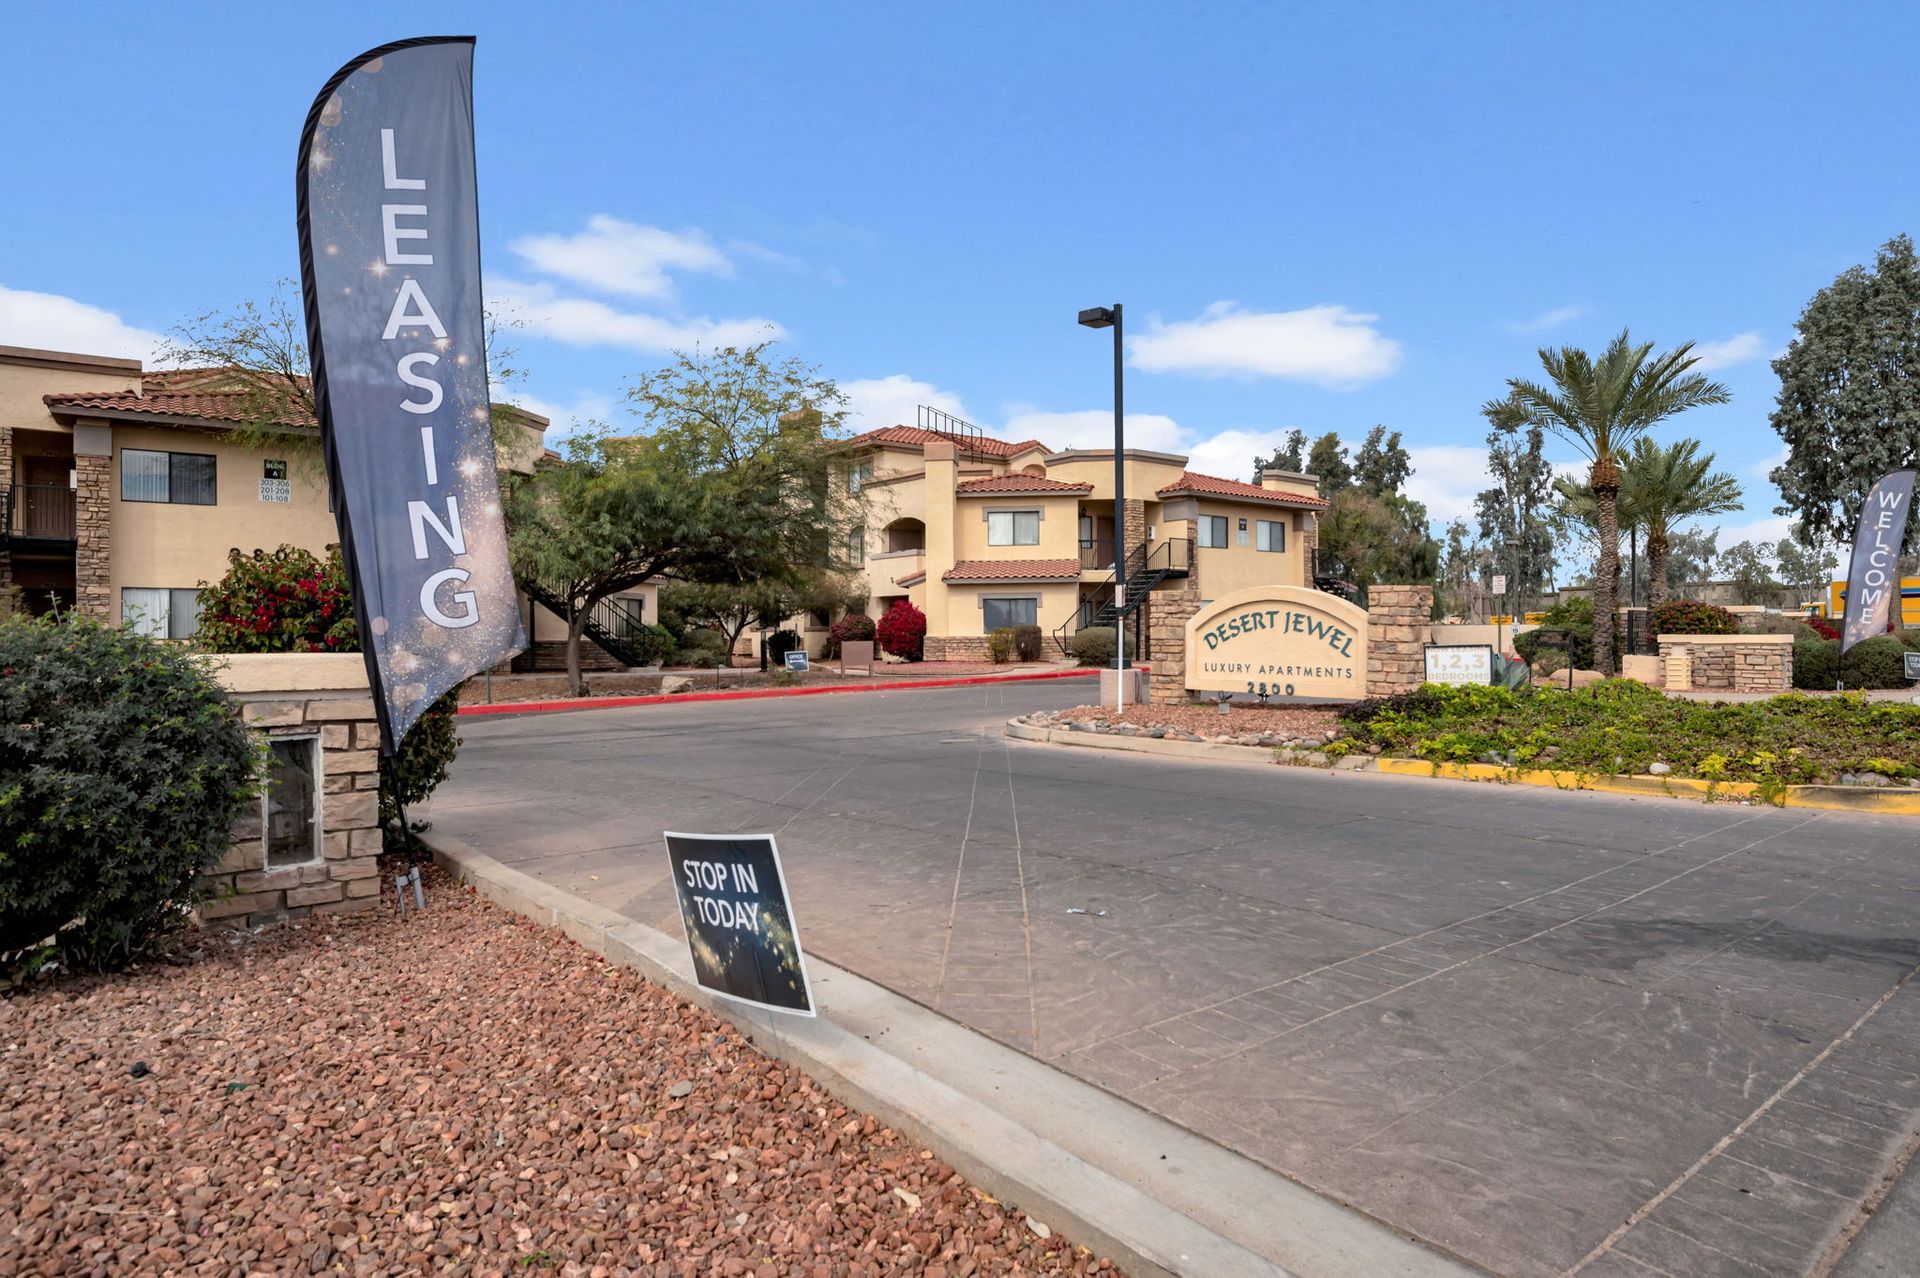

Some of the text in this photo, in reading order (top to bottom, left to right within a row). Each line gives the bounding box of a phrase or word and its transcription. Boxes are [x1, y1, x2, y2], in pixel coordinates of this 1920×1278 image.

[380, 127, 480, 629] LEASING
[260, 487, 290, 495] 201-208
[262, 494, 289, 502] 101-108
[1860, 491, 1903, 625] WELCOME
[1203, 610, 1353, 658] DESERT JEWEL
[1204, 662, 1352, 679] LUXURY APARTMENTS
[1247, 681, 1295, 696] 2800
[683, 859, 759, 893] STOP IN
[693, 896, 759, 935] TODAY
